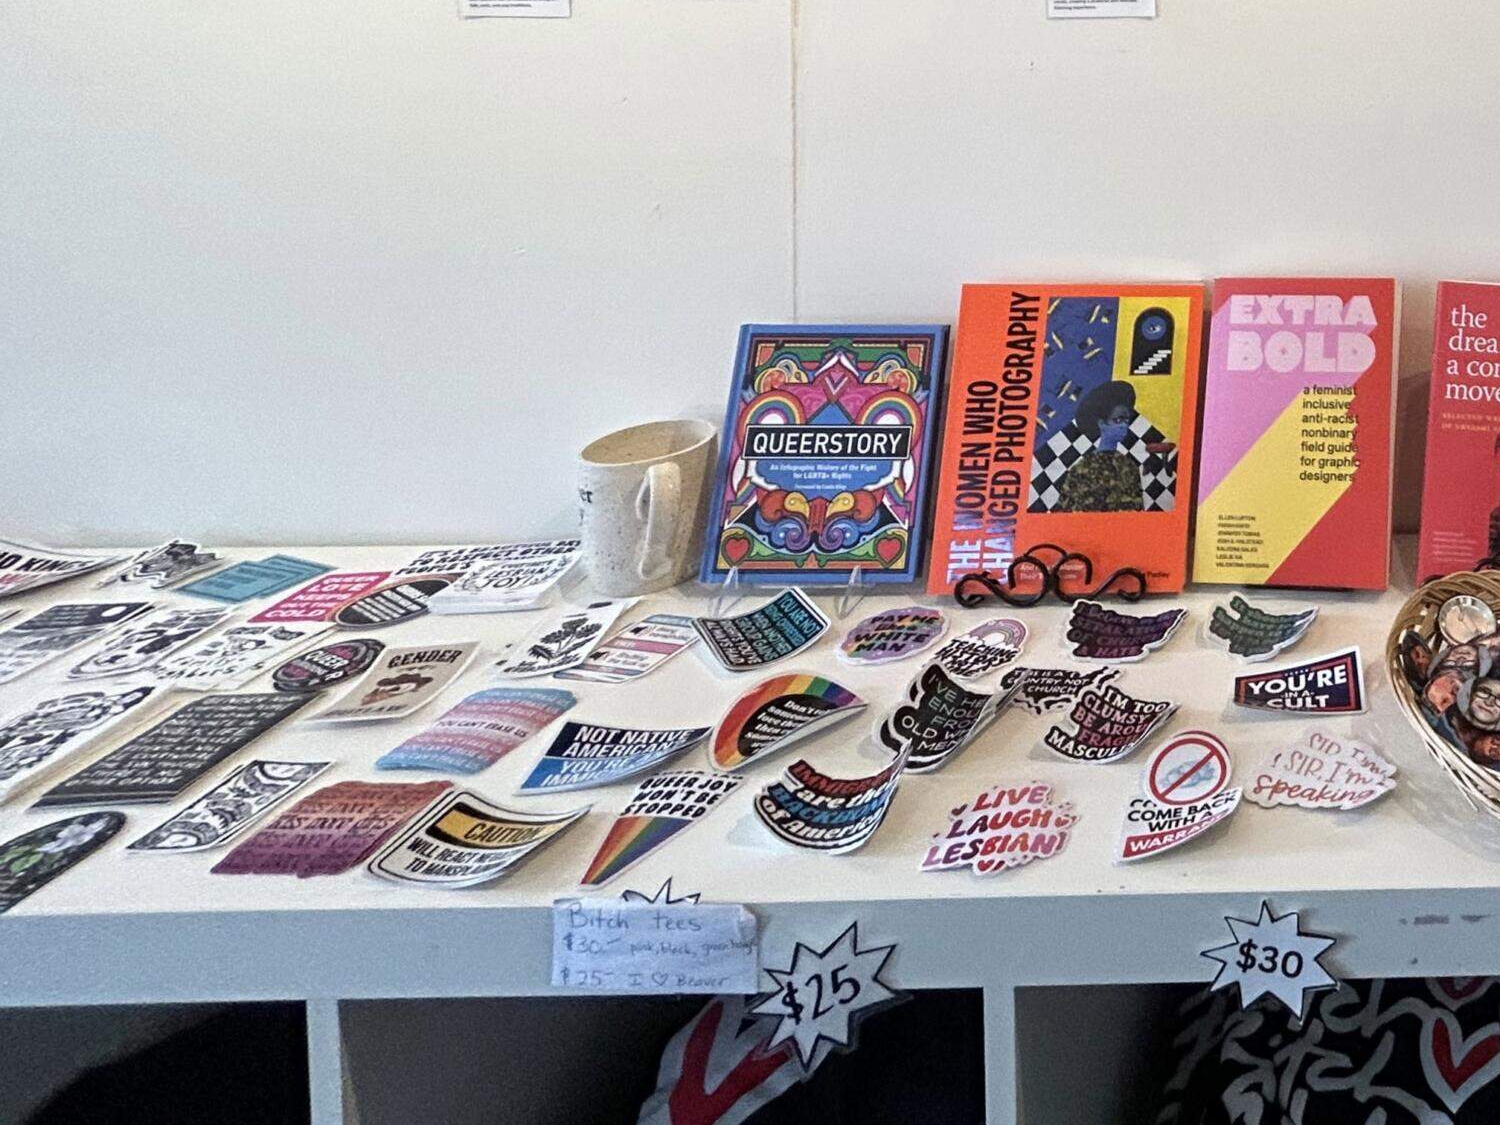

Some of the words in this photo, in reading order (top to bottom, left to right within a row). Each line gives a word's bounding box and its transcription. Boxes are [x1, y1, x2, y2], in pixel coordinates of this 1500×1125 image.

[1229, 295, 1377, 325] EXTRA
[1451, 305, 1488, 328] the
[1227, 331, 1376, 373] BOLD
[993, 292, 1041, 463] PHOTOGRAPHY
[1446, 361, 1459, 375] a
[1303, 387, 1310, 395] a
[1312, 384, 1358, 396] feminist
[963, 380, 998, 436] WHO
[1302, 399, 1351, 410] inclusive
[1302, 412, 1359, 425] anti-racist
[753, 433, 902, 454] QUEERSTORY
[1301, 427, 1358, 441] nonbinary
[1301, 441, 1325, 453] field
[1327, 441, 1359, 456] guide
[1300, 456, 1316, 467] for
[1318, 456, 1361, 470] graphic
[953, 443, 991, 532] WOMEN
[1299, 470, 1357, 484] designers
[982, 469, 1022, 585] CHANGED
[946, 539, 982, 584] THE
[265, 610, 326, 618] COLD
[855, 632, 930, 643] WHITE
[855, 642, 907, 653] MAN
[1249, 664, 1347, 695] YOU'RE
[1084, 694, 1146, 725] CLUMSY
[1133, 702, 1167, 714] TOO
[1266, 694, 1329, 710] CULT
[900, 715, 937, 739] OLD
[1074, 706, 1096, 727] BE
[573, 725, 620, 744] NOT
[623, 730, 690, 745] NATIVE
[639, 775, 695, 790] QUEER
[697, 779, 739, 793] JOY
[1252, 774, 1376, 803] Speaking
[632, 789, 692, 804] WON'T
[695, 792, 723, 805] BE
[797, 788, 845, 808] are
[972, 785, 1049, 812] LIVE
[620, 803, 708, 819] STOPPED
[763, 799, 791, 821] of
[1128, 807, 1183, 822] COME
[1187, 795, 1236, 816] BACK
[463, 823, 544, 844] CAUTION
[946, 809, 1054, 839] LAUGH
[1148, 815, 1197, 832] WITH
[406, 836, 438, 858] WILL
[434, 848, 477, 864] REACT
[404, 858, 424, 873] TO
[568, 902, 630, 929] Bitch
[652, 909, 702, 931] tees
[1236, 940, 1304, 978] $30
[782, 963, 861, 1025] $25
